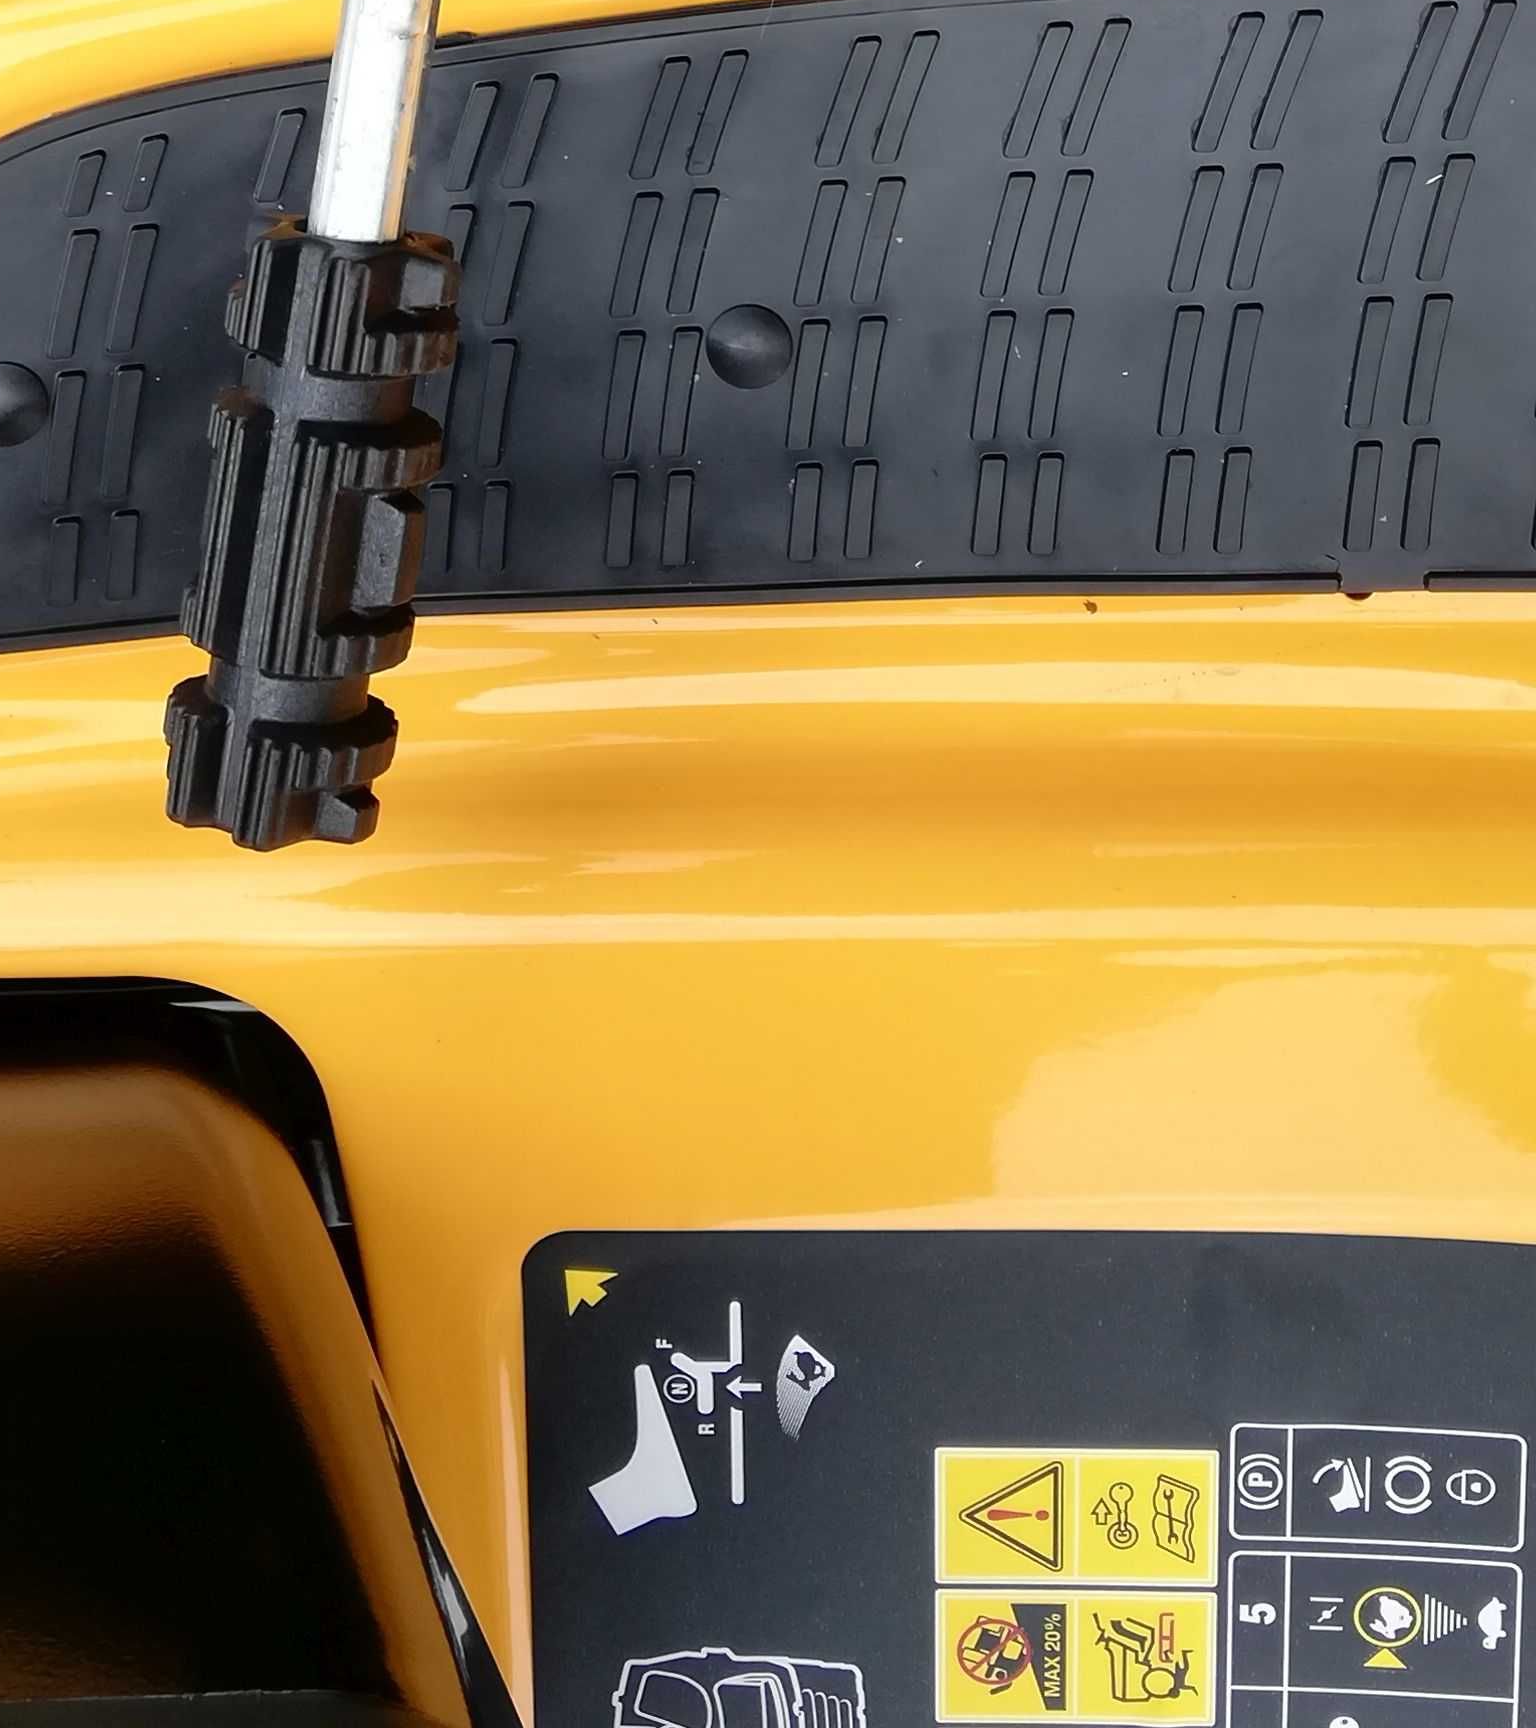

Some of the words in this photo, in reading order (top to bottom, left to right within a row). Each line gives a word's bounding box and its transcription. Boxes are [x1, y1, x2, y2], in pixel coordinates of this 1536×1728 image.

[656, 1338, 673, 1349] F
[671, 1383, 689, 1395] N
[697, 1423, 715, 1435] R
[1248, 1472, 1273, 1488] P
[1239, 1602, 1277, 1625] 5
[1044, 1613, 1062, 1652] 20%
[1044, 1656, 1061, 1697] MAX
